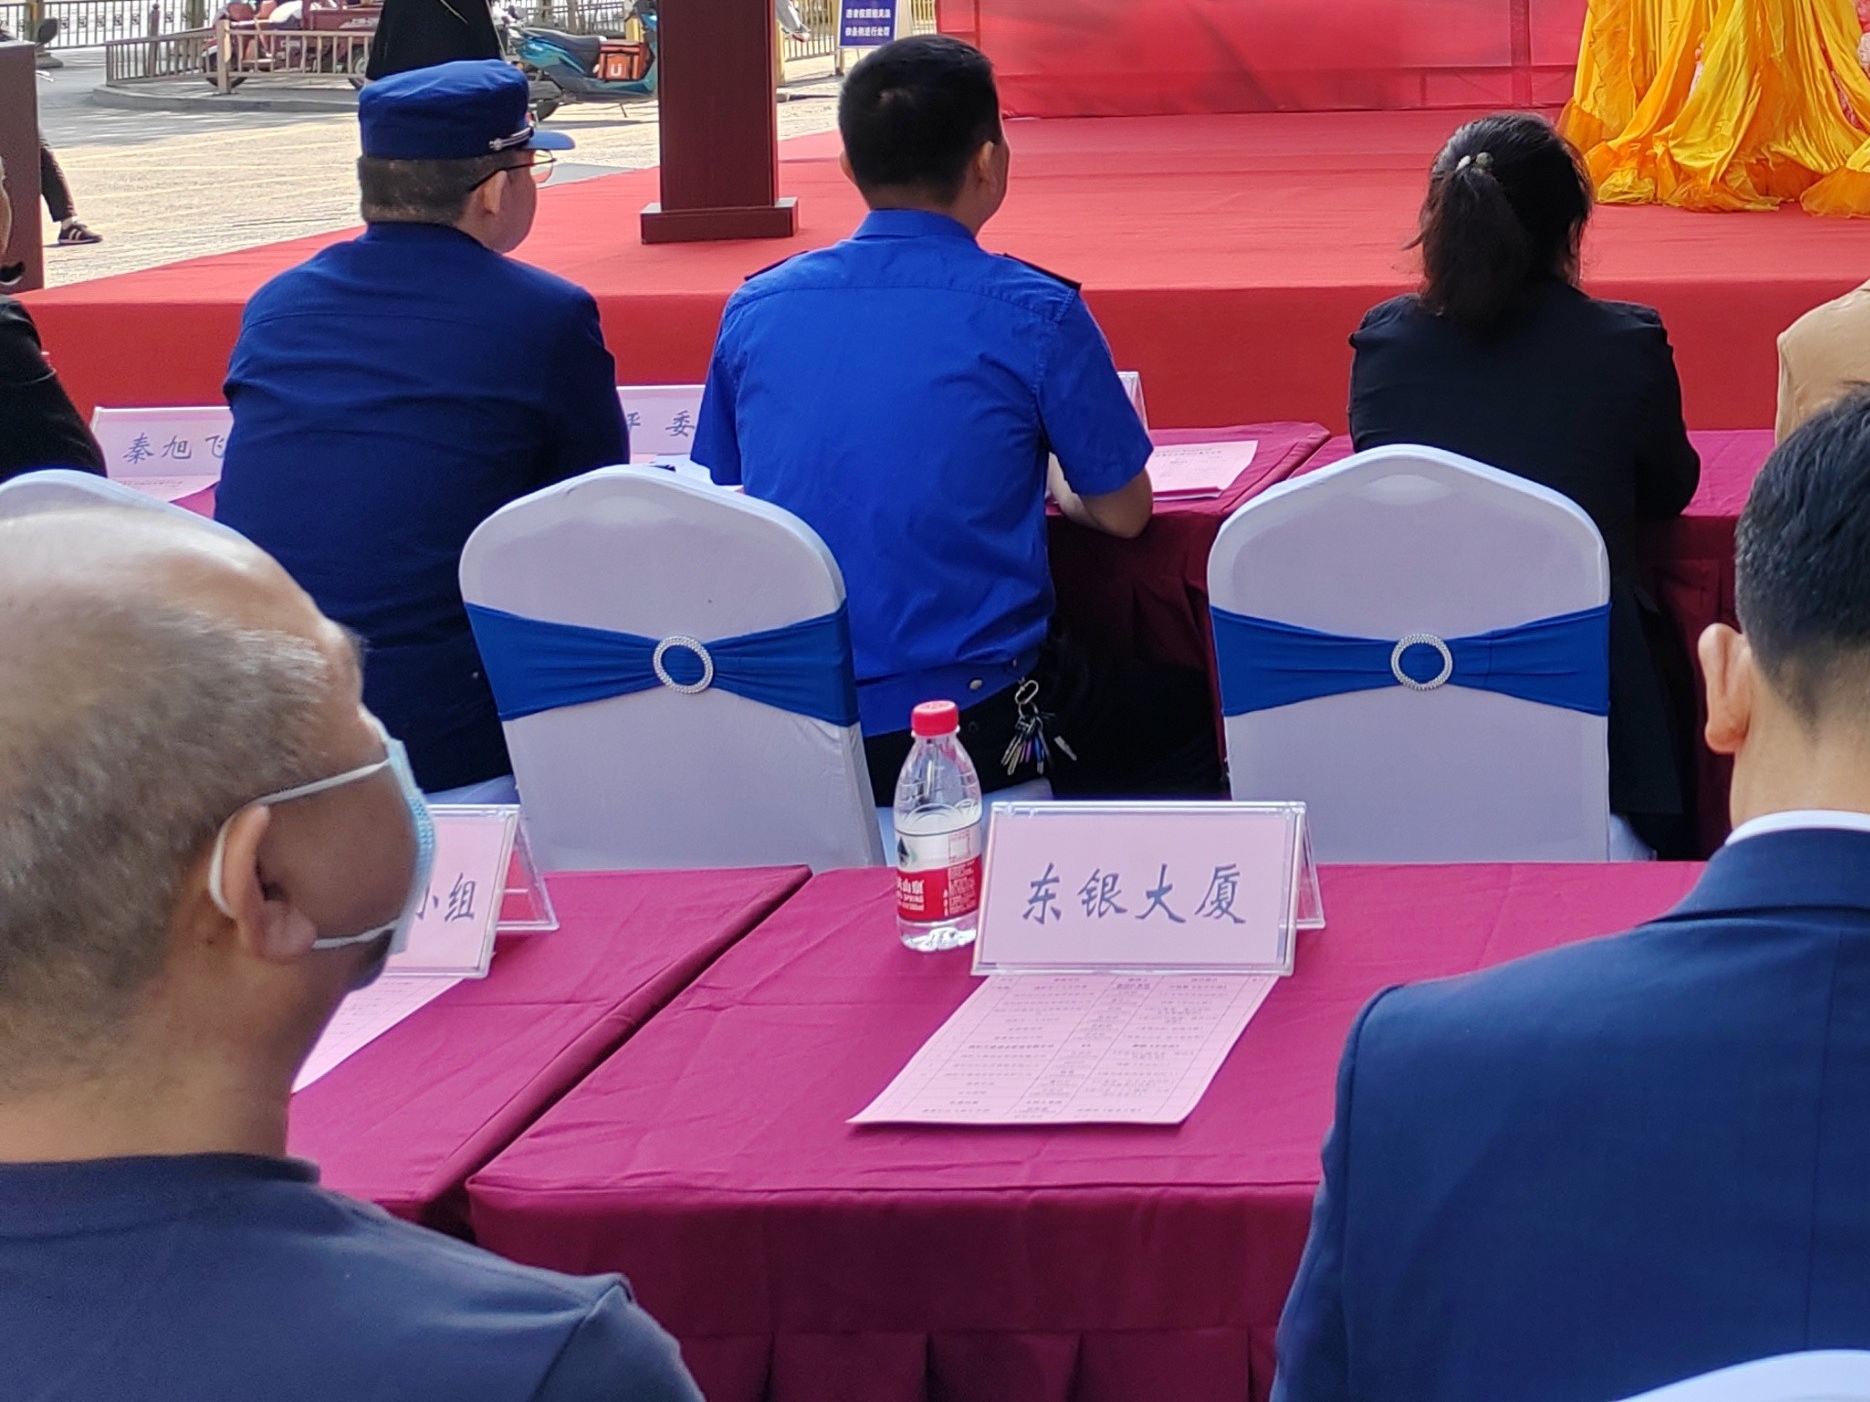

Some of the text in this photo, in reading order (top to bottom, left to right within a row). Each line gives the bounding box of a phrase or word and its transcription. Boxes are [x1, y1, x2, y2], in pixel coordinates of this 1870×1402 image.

[122, 432, 224, 465] 秦旭飞
[1022, 862, 1246, 925] 东银大厦
